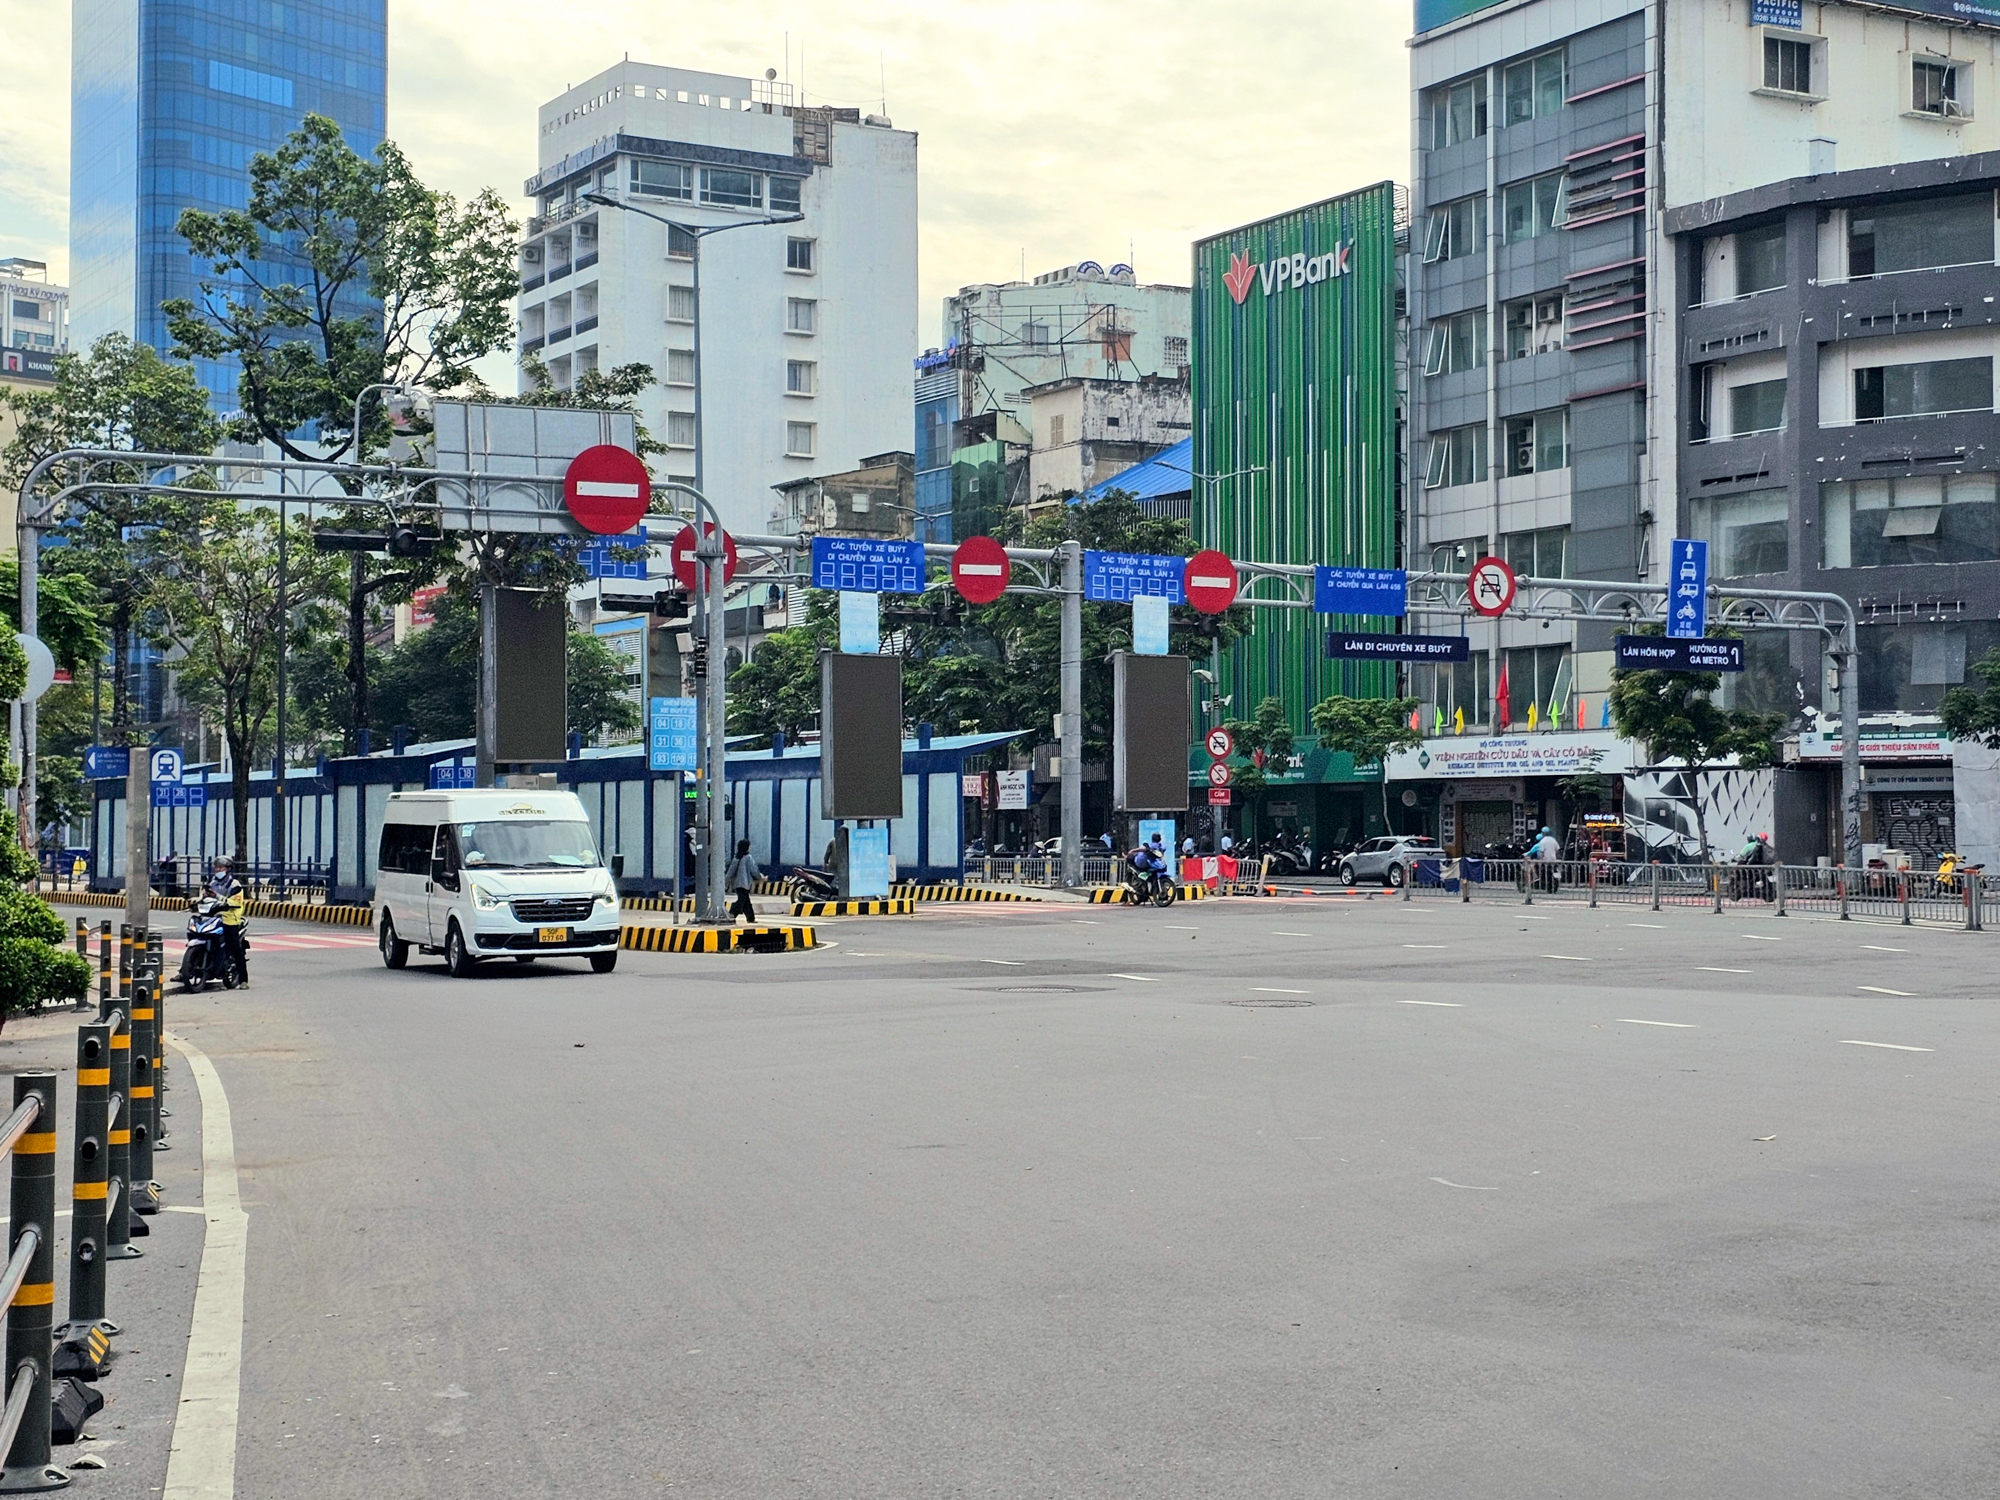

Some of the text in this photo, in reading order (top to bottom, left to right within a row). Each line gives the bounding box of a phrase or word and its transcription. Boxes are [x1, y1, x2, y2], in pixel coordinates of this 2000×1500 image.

[1259, 240, 1351, 297] VPBank
[831, 541, 846, 550] CÁC
[849, 541, 872, 551] TUYẾN
[888, 545, 907, 553] BUÝT
[888, 555, 902, 564] LÀN
[1102, 555, 1115, 564] CÁC
[1117, 555, 1138, 565] TUYẾN
[1153, 558, 1171, 567] BUÝT
[1154, 568, 1168, 577] LÀN
[1330, 570, 1343, 578] CÁC
[1345, 570, 1365, 579] TUYẾN
[1378, 572, 1393, 580] BUÝT
[1376, 581, 1389, 590] LÀN
[1345, 640, 1363, 650] LÀN
[1415, 645, 1426, 653] XE
[1428, 644, 1452, 654] BUÝT
[1689, 643, 1717, 654] HƯỚNG
[1622, 646, 1639, 656] LÀN
[1659, 648, 1676, 659] HỢP
[1690, 656, 1729, 665] GA METRO
[657, 720, 666, 728] 04
[440, 769, 472, 778] 04 18
